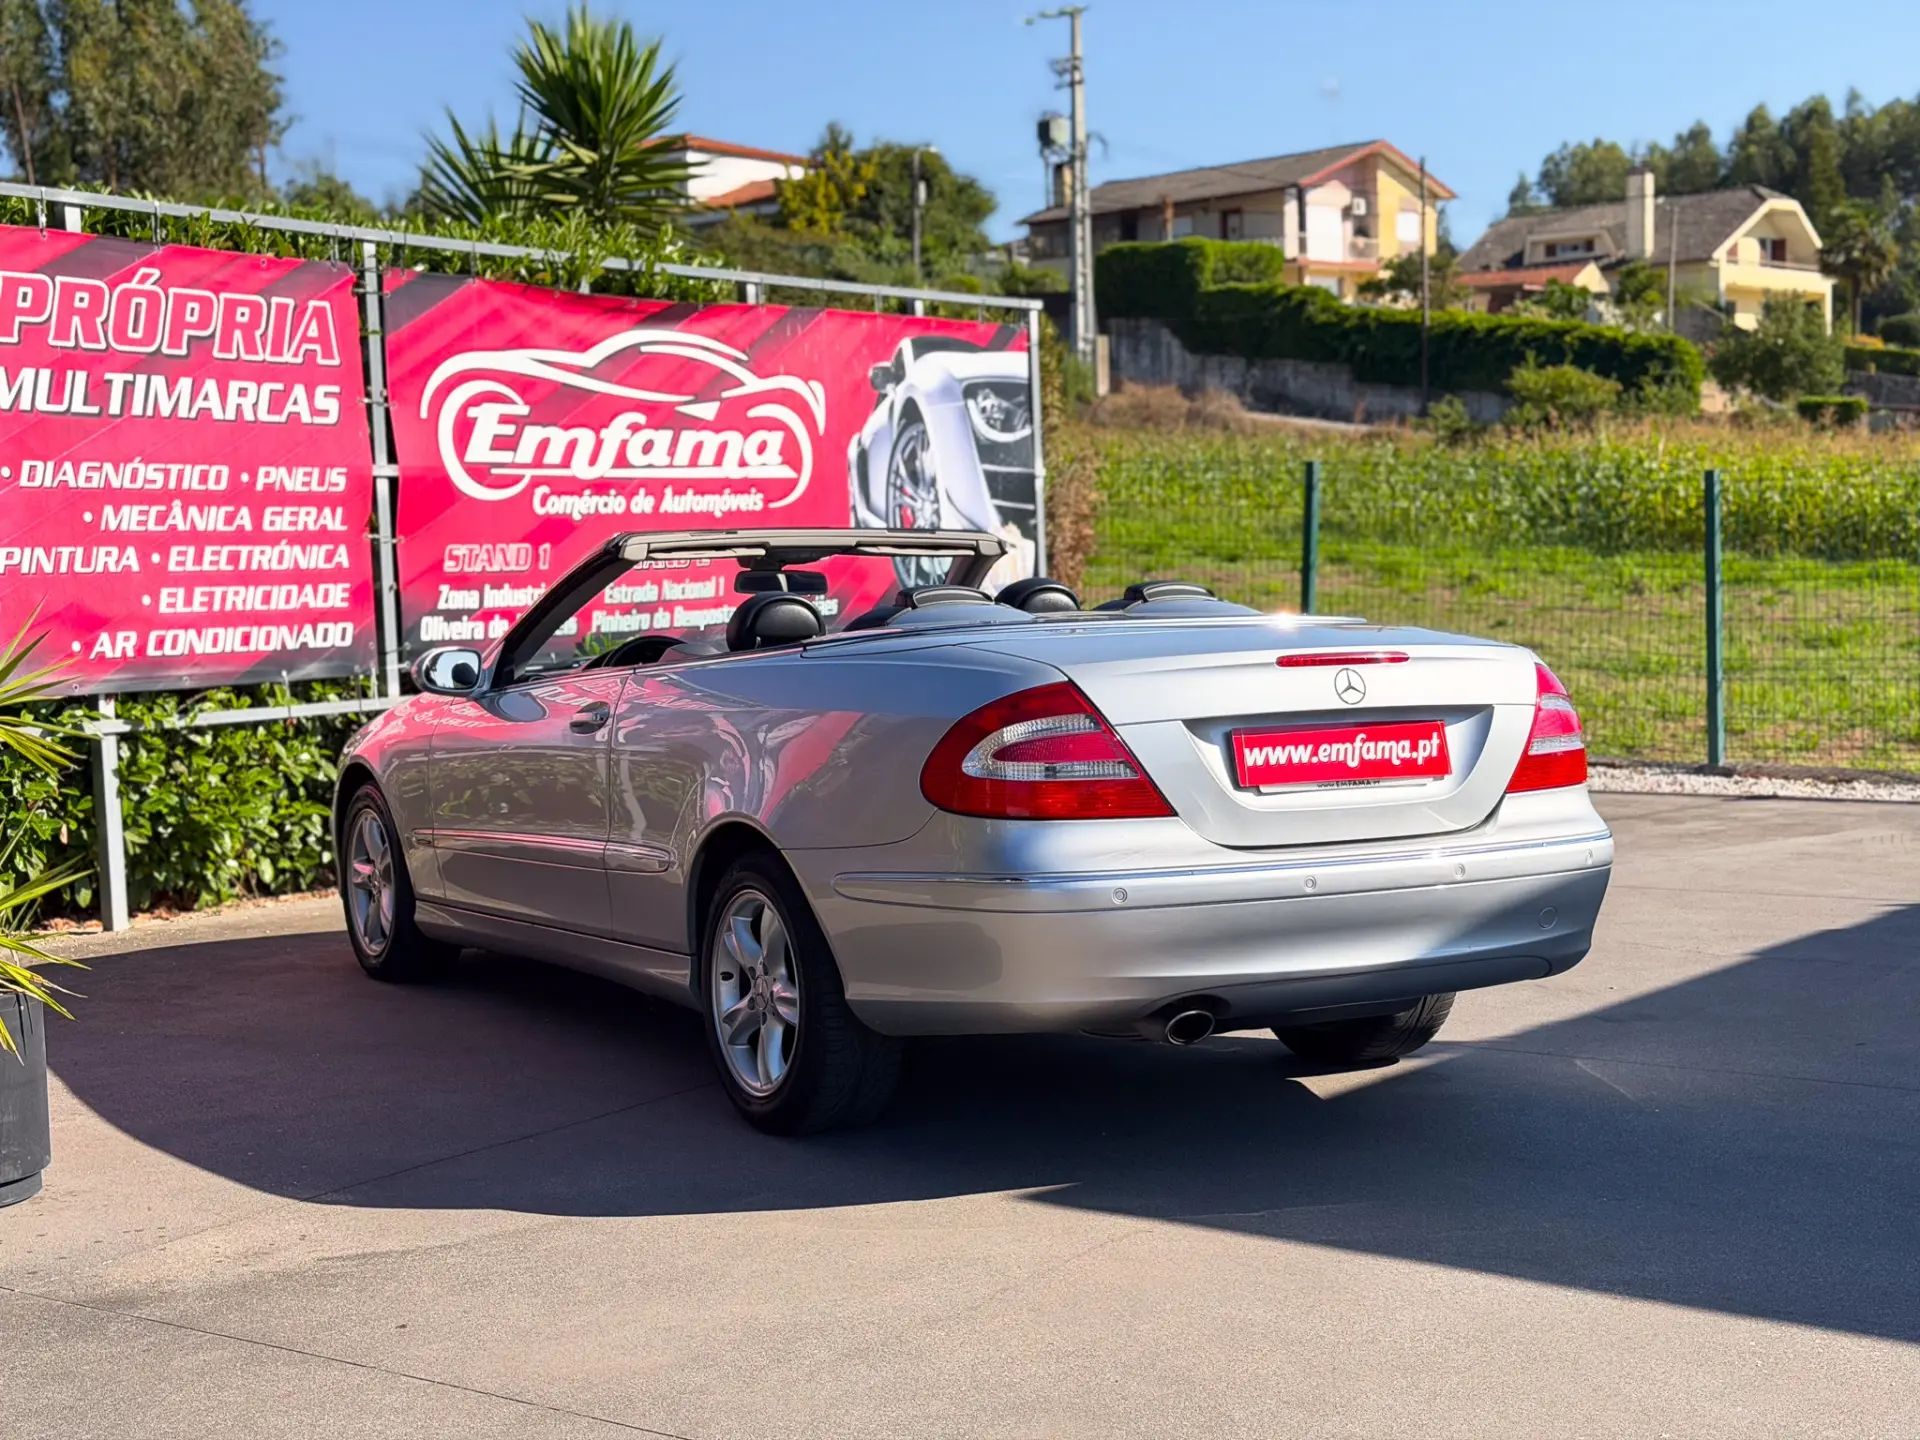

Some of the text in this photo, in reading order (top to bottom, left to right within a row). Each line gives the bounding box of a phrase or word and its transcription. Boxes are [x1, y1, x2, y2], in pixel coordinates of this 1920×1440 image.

[0, 268, 341, 366] PRÓPRIA
[0, 366, 341, 425] MULTIMARCAS
[464, 403, 785, 480] Emfama
[20, 457, 347, 492] DIAGNÓSTICO PNEUS
[101, 499, 348, 532] MECÂNICA GERAL
[532, 485, 764, 520] Comércio de Automóveis
[0, 540, 349, 574] PINTURA ELECTRÓNICA
[443, 542, 551, 572] STAND 1
[159, 583, 350, 613] ELETRICIDADE
[437, 582, 546, 609] Zona Industri
[604, 580, 659, 604] Estrada
[662, 576, 716, 600] Nacional
[420, 615, 485, 641] Oliveira
[488, 614, 509, 639] de
[591, 608, 650, 633] Pinheiro
[90, 622, 353, 660] AR CONDICIONADO
[1244, 732, 1440, 768] www.emfama.pt
